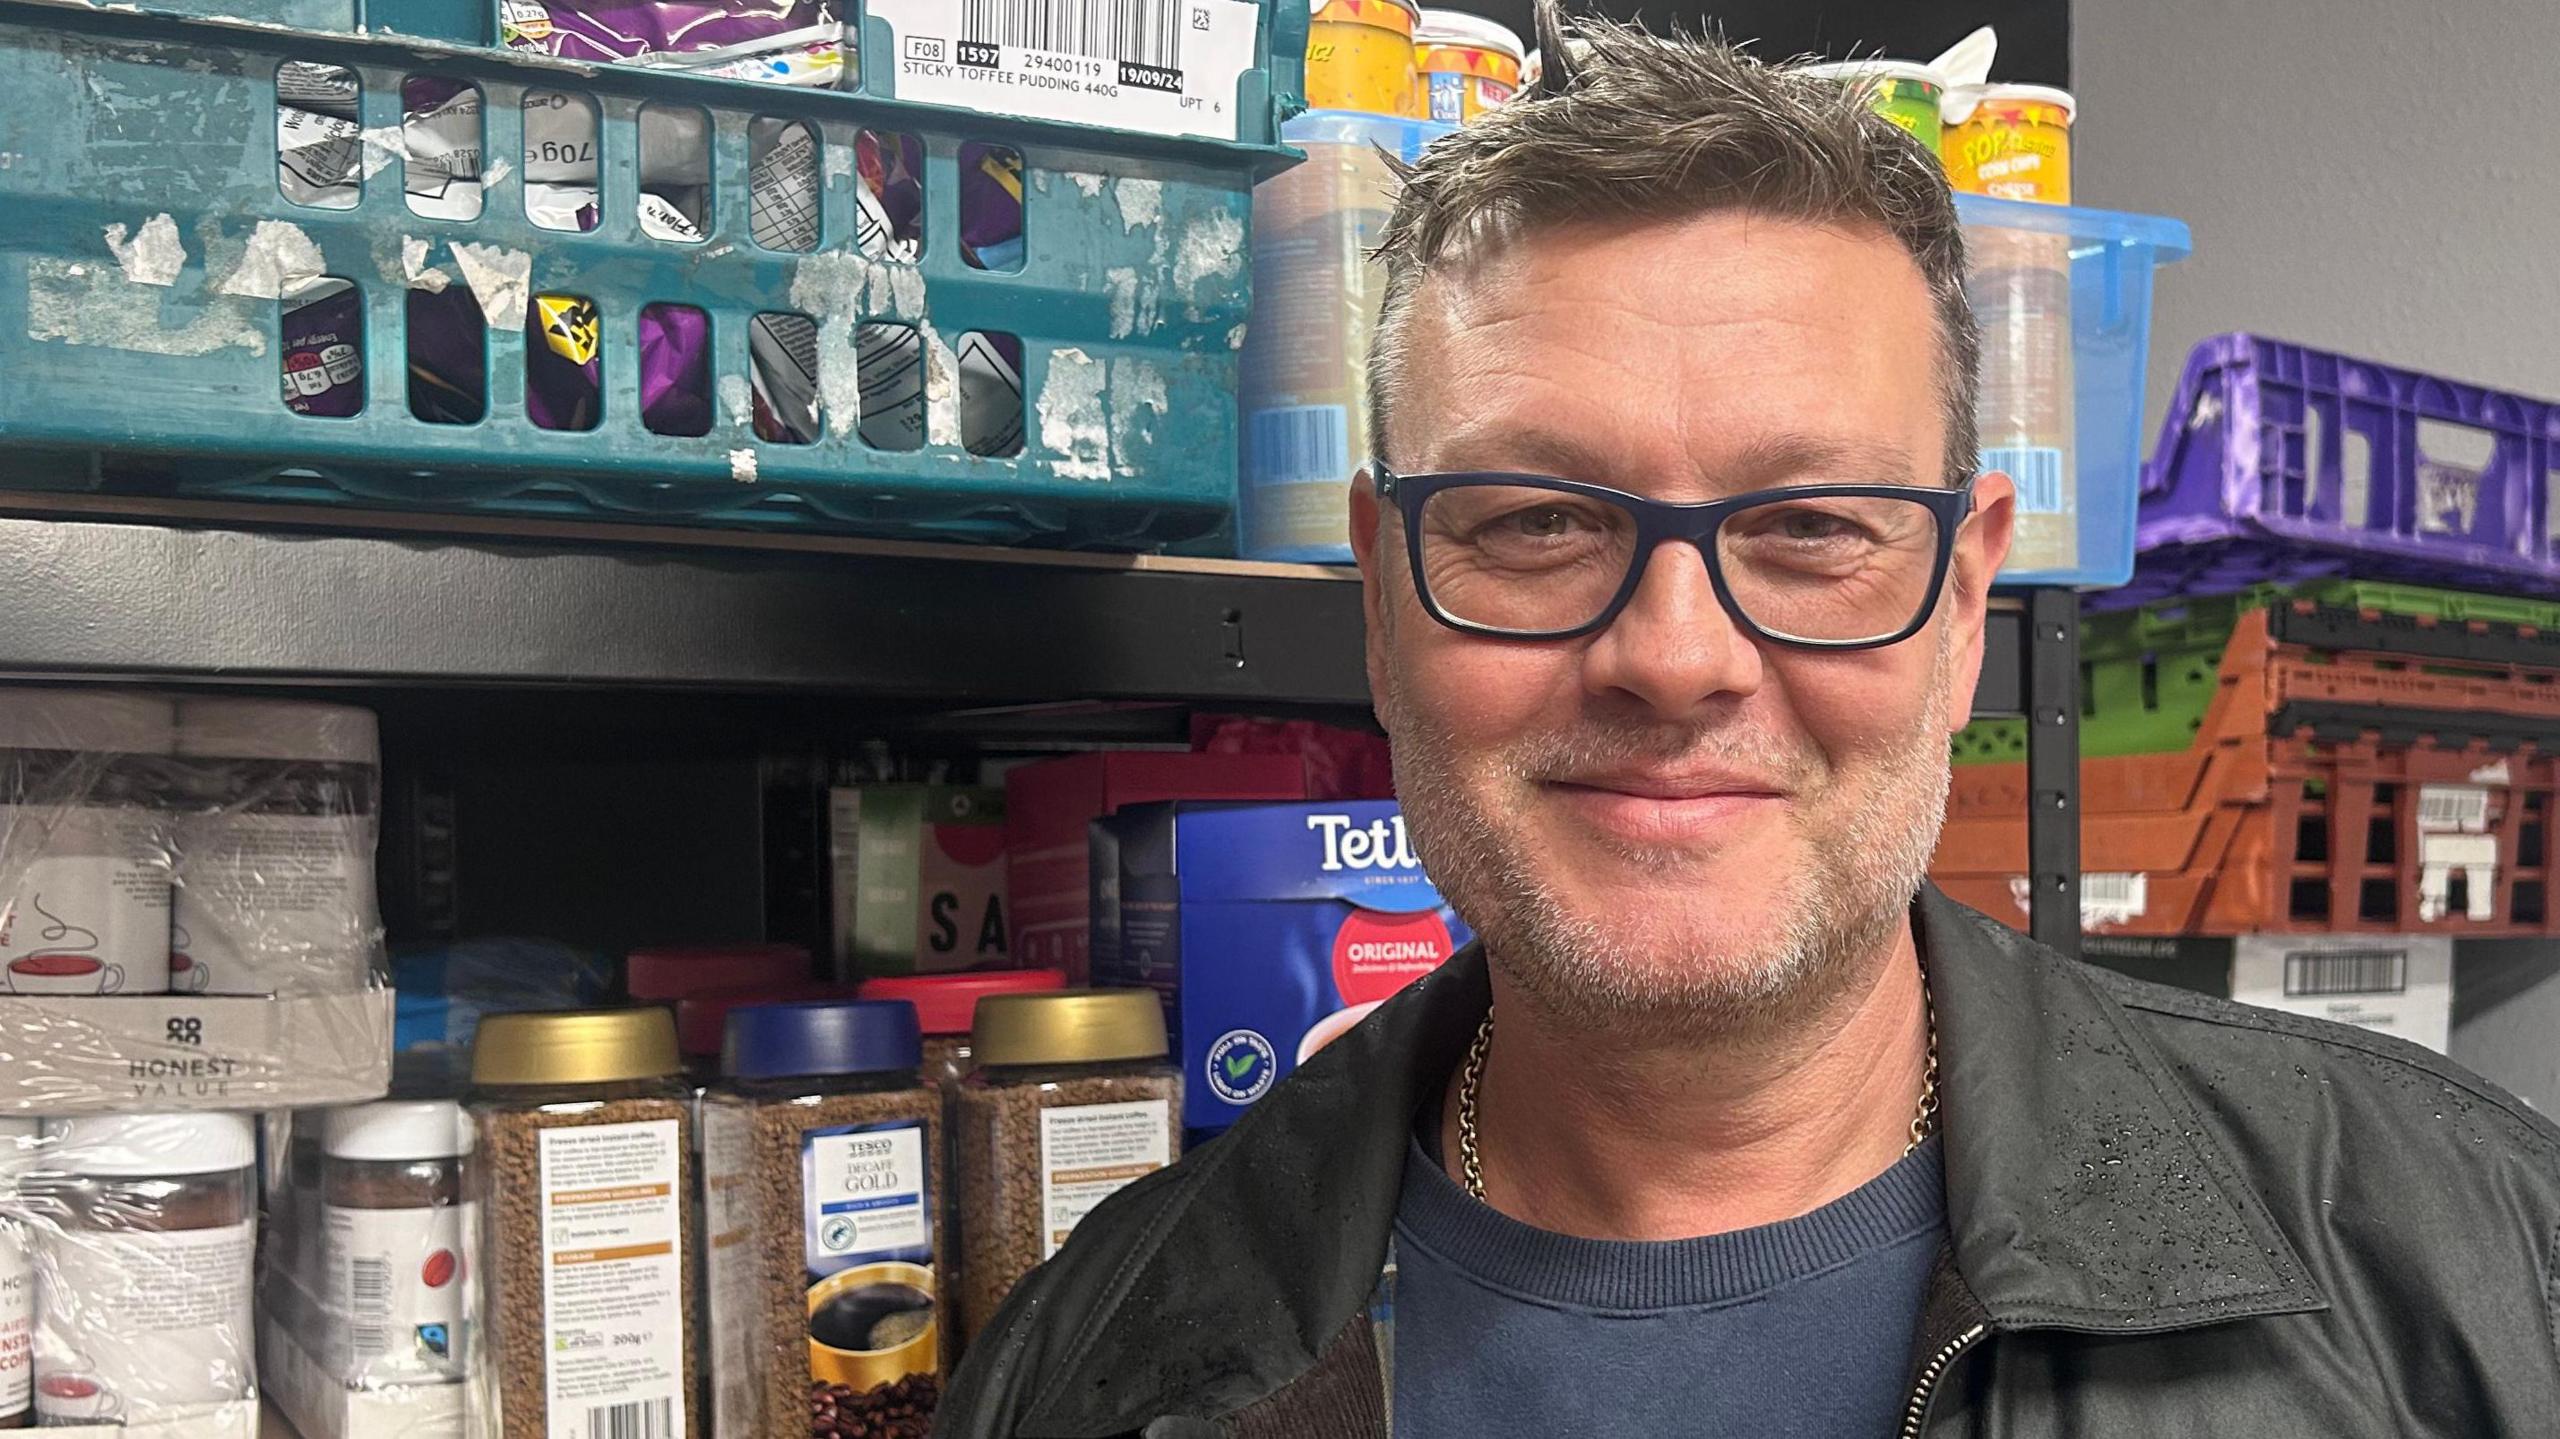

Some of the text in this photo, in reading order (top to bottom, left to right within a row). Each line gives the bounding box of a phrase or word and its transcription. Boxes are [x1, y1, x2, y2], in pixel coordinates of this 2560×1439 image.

[913, 42, 1183, 91] F08 1597 29400119 19/09/24
[903, 61, 1119, 98] STICKY TOFFEE PUDDING 440G
[1180, 95, 1222, 113] UPT 6
[541, 142, 594, 164] 70g
[1306, 814, 1424, 872] Tetl
[1347, 942, 1440, 963] ORIGINAL
[129, 1057, 237, 1078] HONEST
[135, 1082, 230, 1098] VALUE
[848, 1138, 892, 1152] TESCO
[844, 1171, 898, 1193] GOLD
